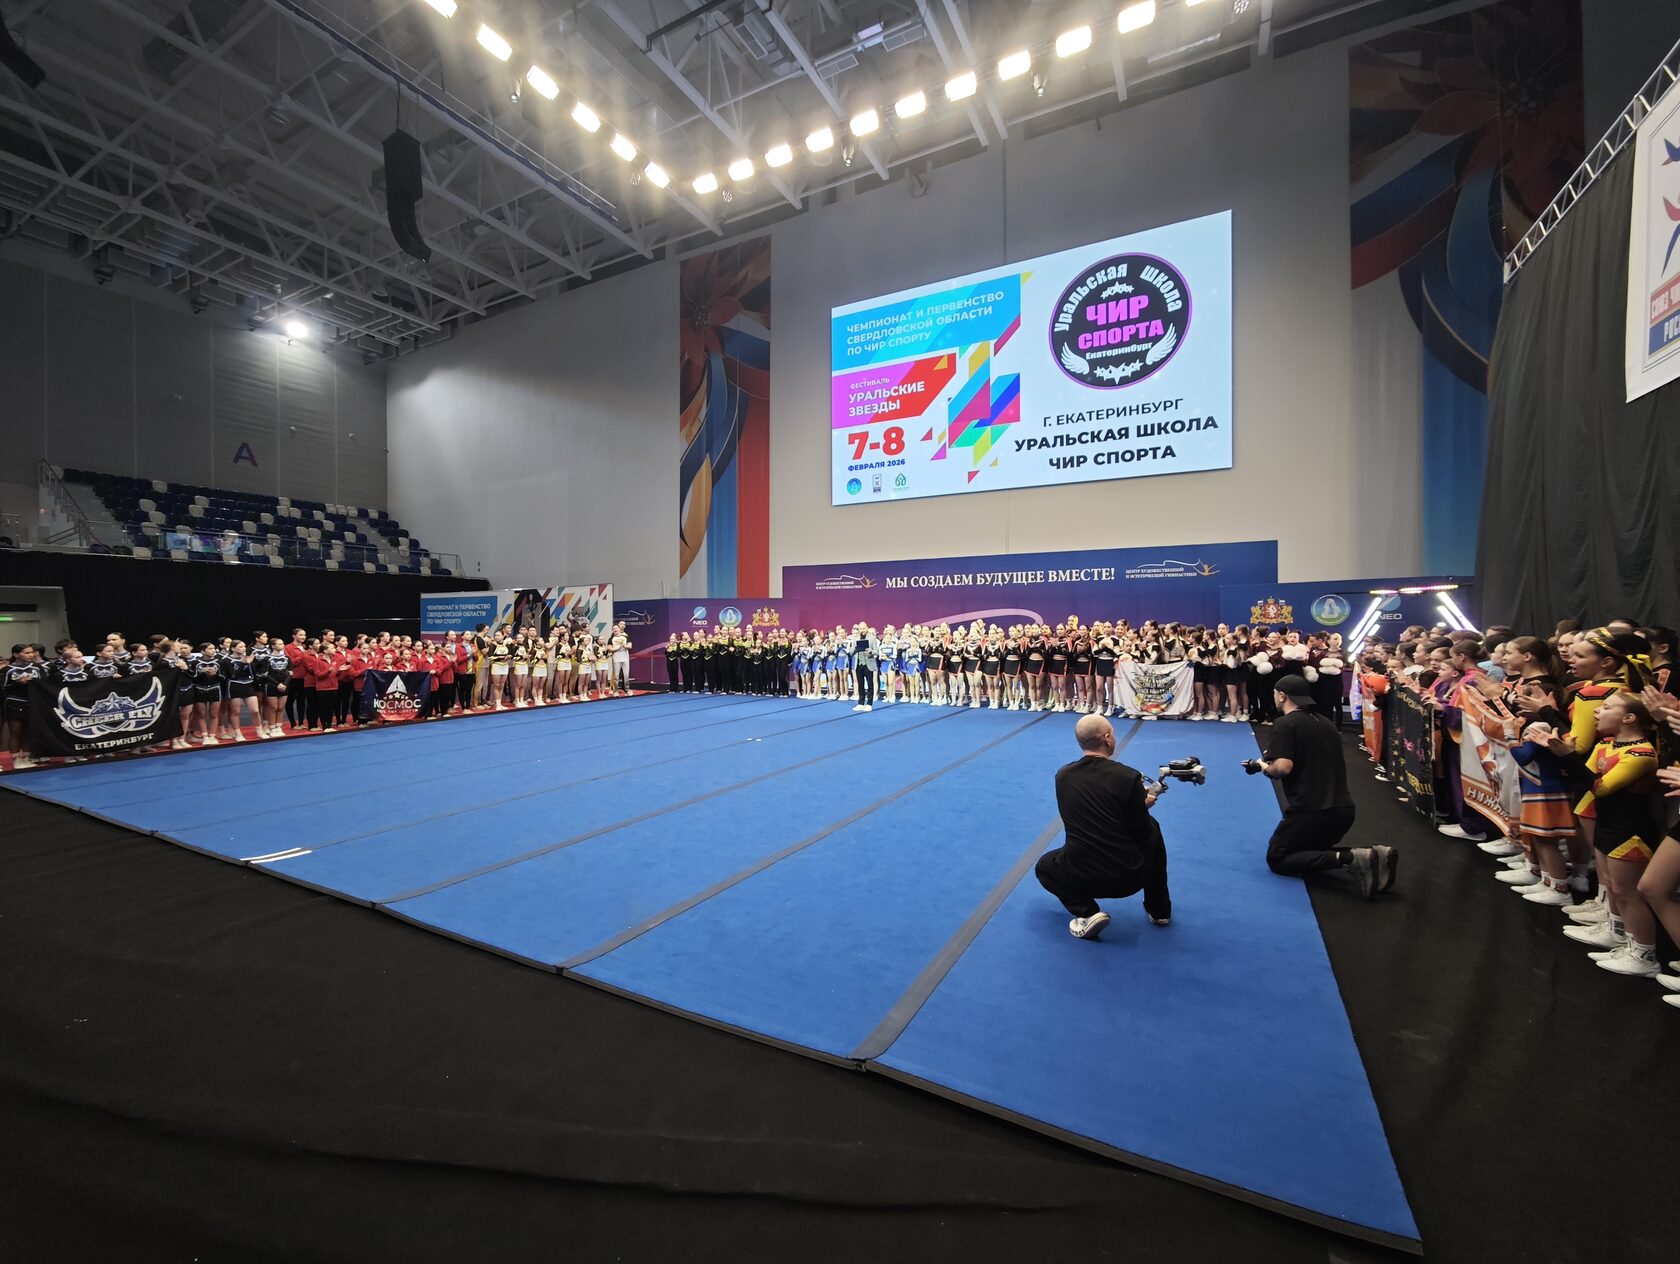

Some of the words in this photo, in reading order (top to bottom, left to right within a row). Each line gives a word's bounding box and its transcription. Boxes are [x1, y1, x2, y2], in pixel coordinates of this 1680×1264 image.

[847, 311, 912, 334] ЧЕМПИОНАТ
[916, 310, 924, 319] И
[927, 291, 1004, 316] ПЕРВЕНСТВО
[1086, 295, 1149, 326] ЧИР
[847, 318, 934, 345] СВЕРДЛОВСКОЙ
[936, 306, 993, 325] ОБЛАСТИ
[1078, 319, 1165, 350] СПОРТА
[847, 346, 862, 356] ПО
[864, 341, 886, 352] ЧИР
[888, 331, 931, 348] СПОРТУ
[1085, 341, 1153, 360] Екатеринбург
[848, 381, 925, 404] УРАЛЬСКИЕ
[849, 378, 890, 390] ФЕСТИВАЛЬ
[848, 399, 900, 417] ЗВЕЗДЫ
[1043, 416, 1052, 427] Г.
[1056, 398, 1183, 426] ЕКАТЕРИНБУРГ
[848, 426, 905, 460] 7-8
[1014, 427, 1129, 452] УРАЛЬСКАЯ
[1136, 416, 1219, 438] ШКОЛА
[848, 462, 886, 471] ФЕВРАЛЯ
[887, 459, 905, 467] 2026
[1049, 455, 1088, 470] ЧИР
[1093, 445, 1177, 466] СПОРТА
[886, 577, 908, 589] МЫ
[910, 574, 974, 588] СОЗДАЕМ
[976, 571, 1045, 587] БУДУЩЕЕ
[1048, 568, 1115, 582] ВМЕСТЕ!
[373, 699, 421, 709] КОСМОС
[71, 711, 124, 728] CHEER
[128, 706, 153, 719] FLY
[75, 732, 154, 751] ЕКАТЕРИНБУРГ
